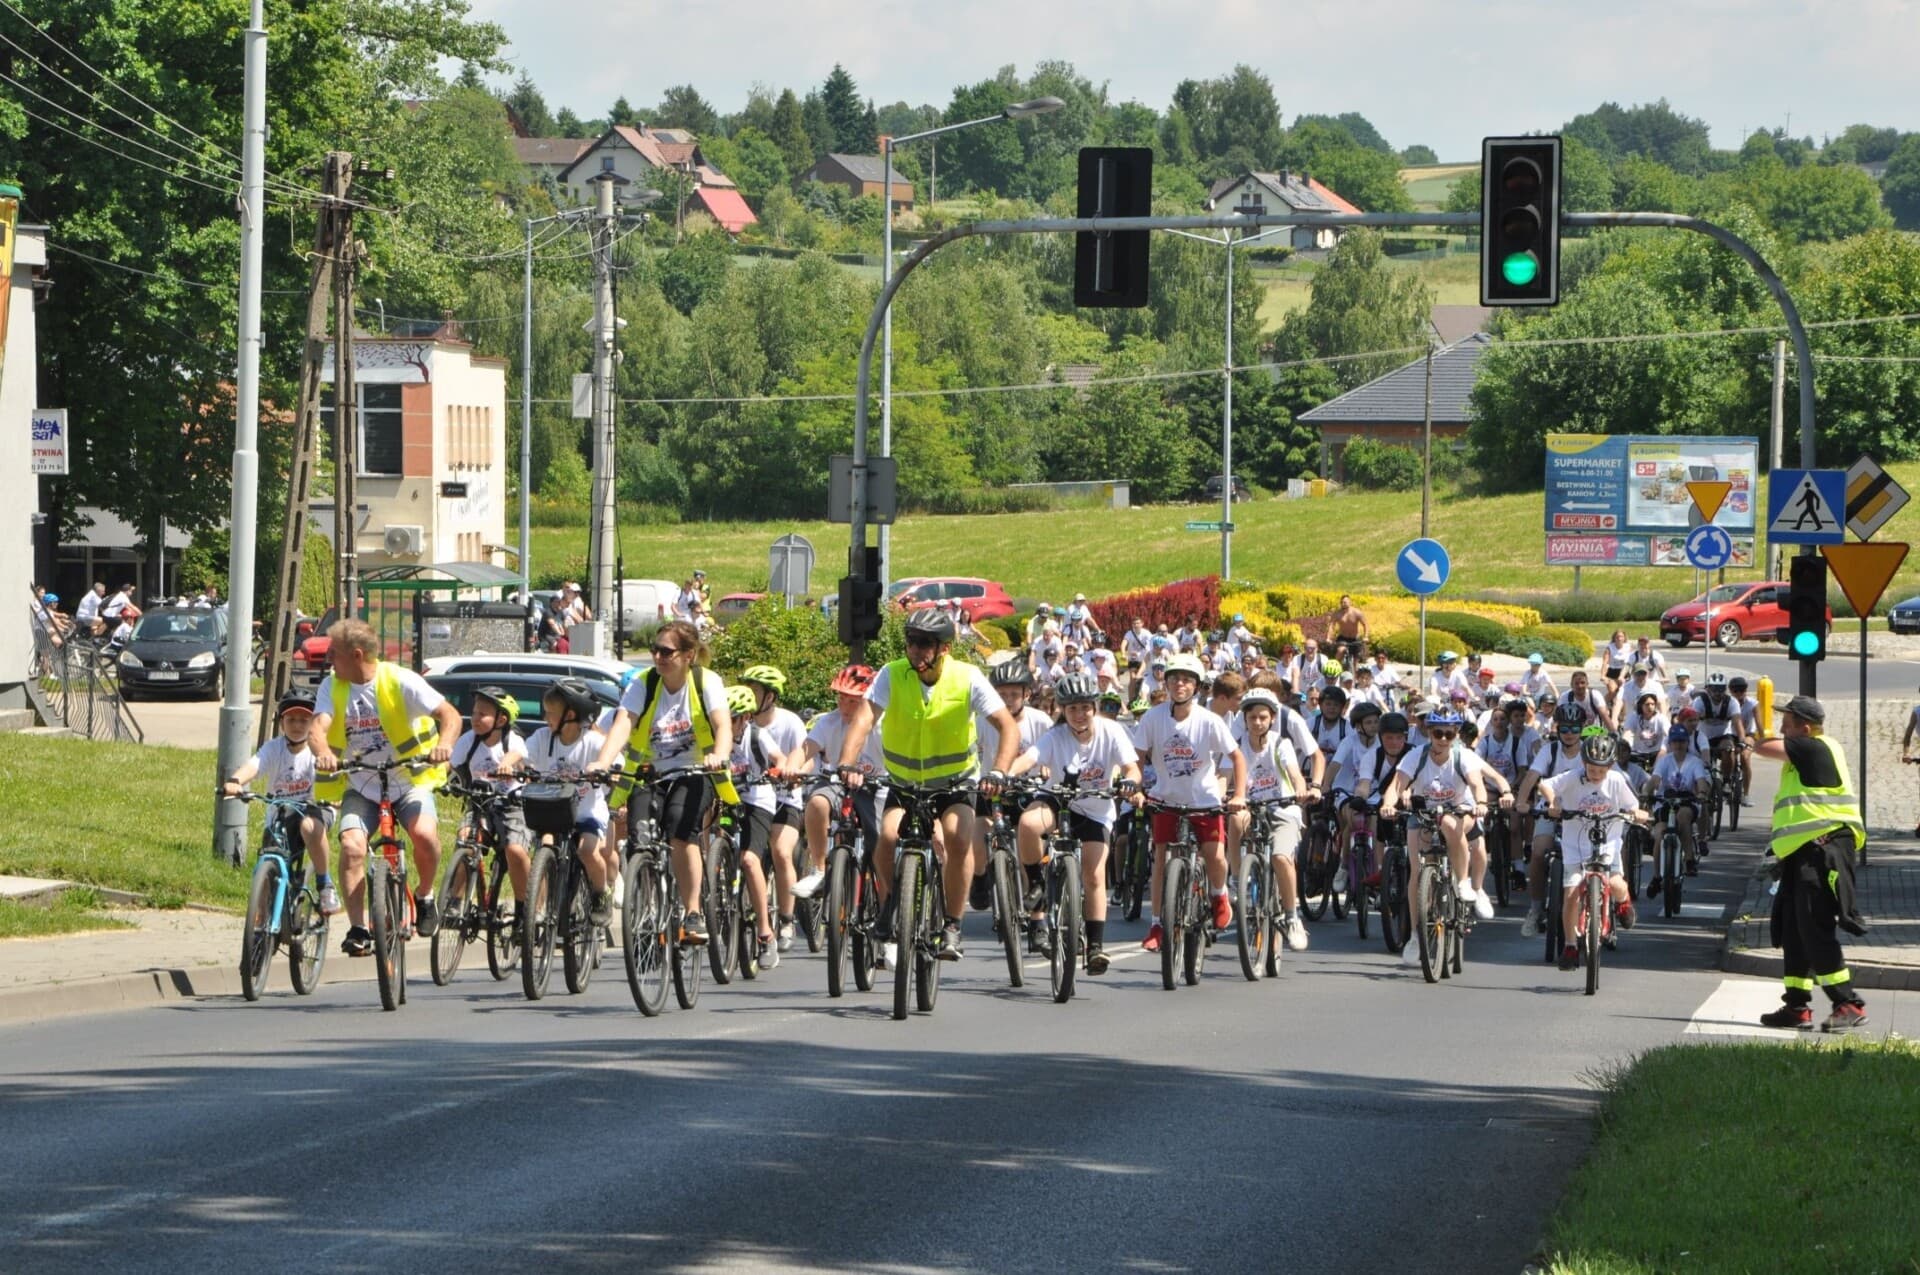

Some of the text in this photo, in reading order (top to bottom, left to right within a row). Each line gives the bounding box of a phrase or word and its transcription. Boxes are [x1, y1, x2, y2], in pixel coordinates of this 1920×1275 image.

[32, 418, 52, 431] ele
[32, 448, 63, 457] STWINA
[1554, 458, 1622, 468] SUPERMARKET
[1560, 516, 1597, 526] MYJNIA
[1551, 542, 1604, 553] MYJNIA
[359, 718, 380, 729] RAJD
[1174, 747, 1193, 756] RAJD
